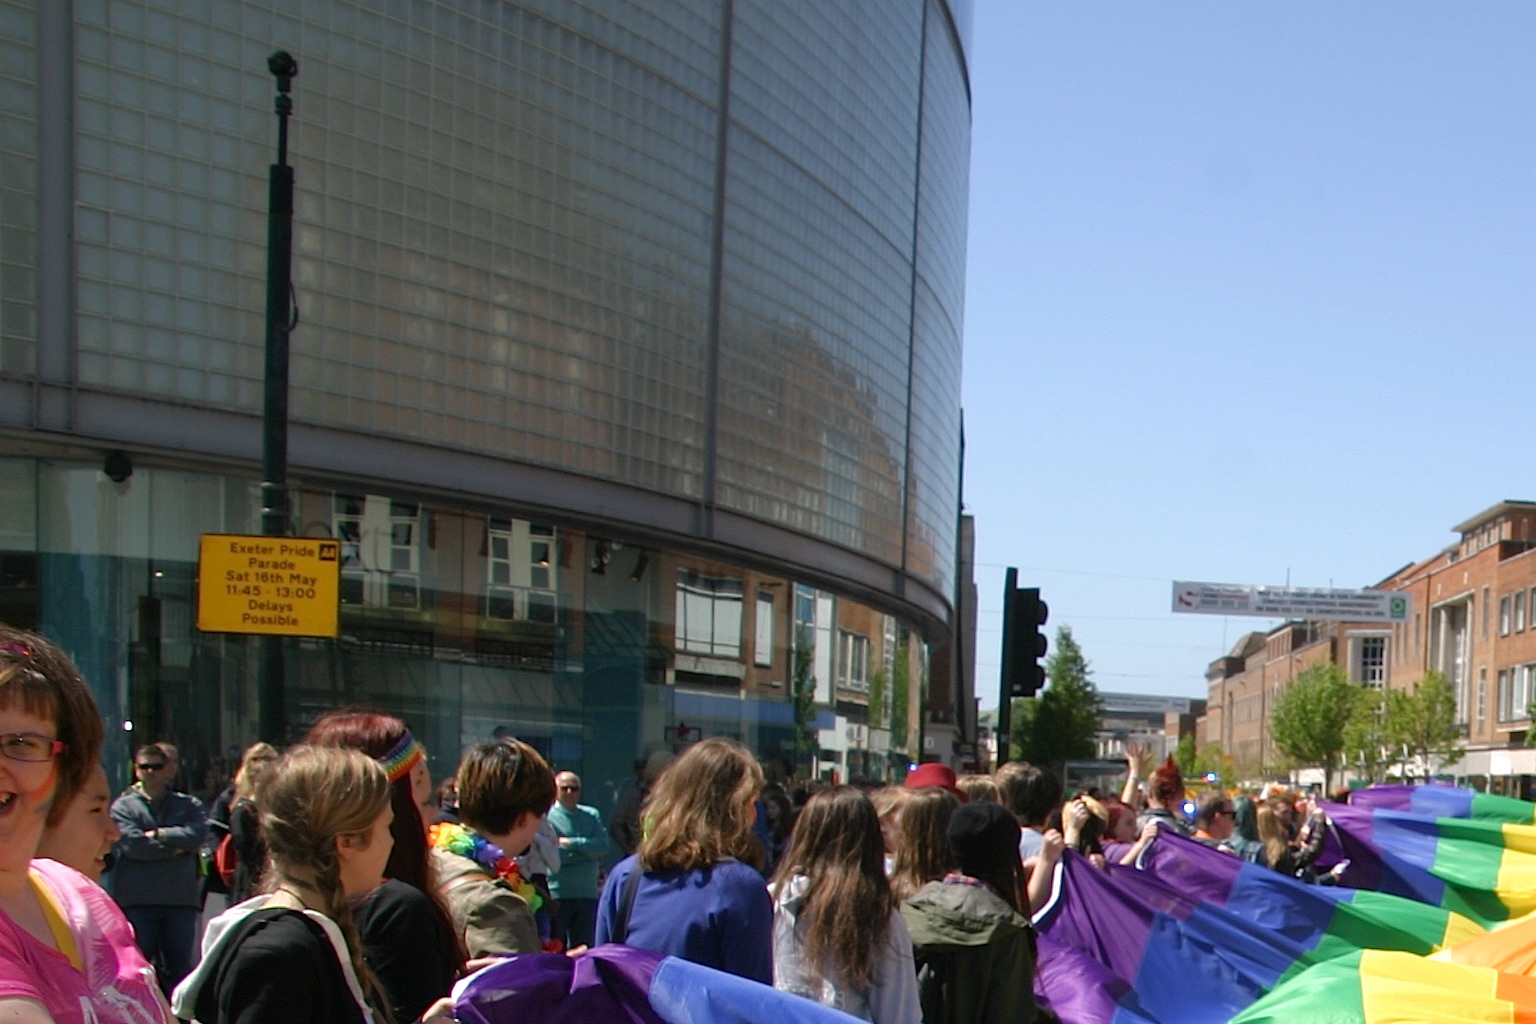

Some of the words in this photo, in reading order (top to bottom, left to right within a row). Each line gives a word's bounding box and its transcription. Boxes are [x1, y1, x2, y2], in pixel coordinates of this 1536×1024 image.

[230, 542, 275, 555] Exeter
[280, 544, 315, 557] Pride
[249, 557, 296, 570] Parade
[226, 570, 250, 582] Sat
[255, 571, 284, 584] 16th
[289, 573, 317, 586] May
[248, 599, 294, 613] Delays
[242, 613, 299, 626] Possible
